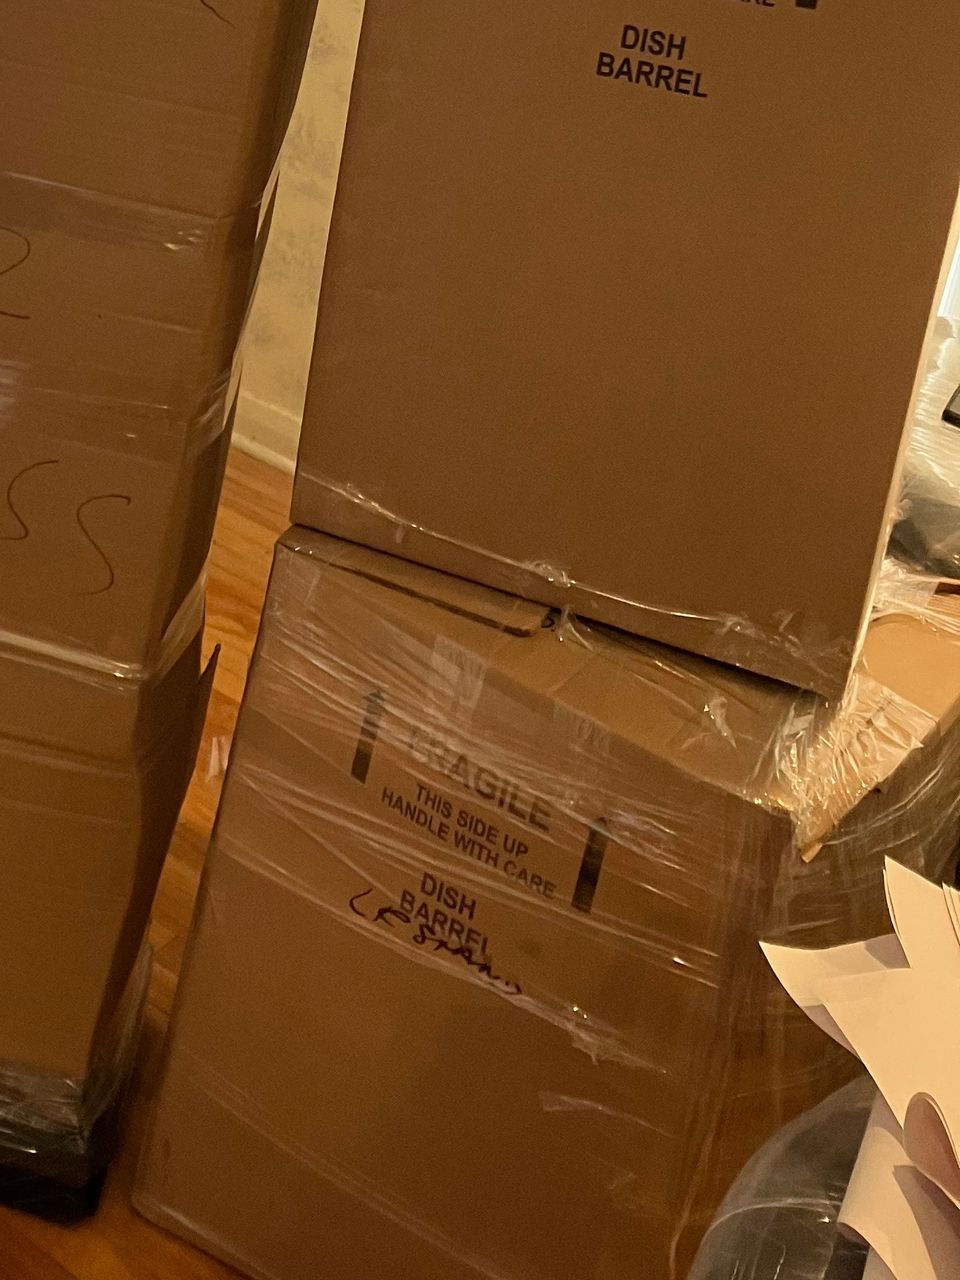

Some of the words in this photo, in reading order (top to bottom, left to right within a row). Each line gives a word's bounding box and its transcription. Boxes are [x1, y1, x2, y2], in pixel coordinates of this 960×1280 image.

[620, 24, 686, 61] DISH
[596, 51, 708, 98] BARREL
[381, 786, 451, 842] HANDLE
[453, 829, 500, 868] WITH
[503, 859, 558, 900] CARE
[415, 782, 453, 819] THIS
[456, 808, 499, 846] SIDE
[503, 833, 529, 858] UP
[420, 871, 477, 921] DISH
